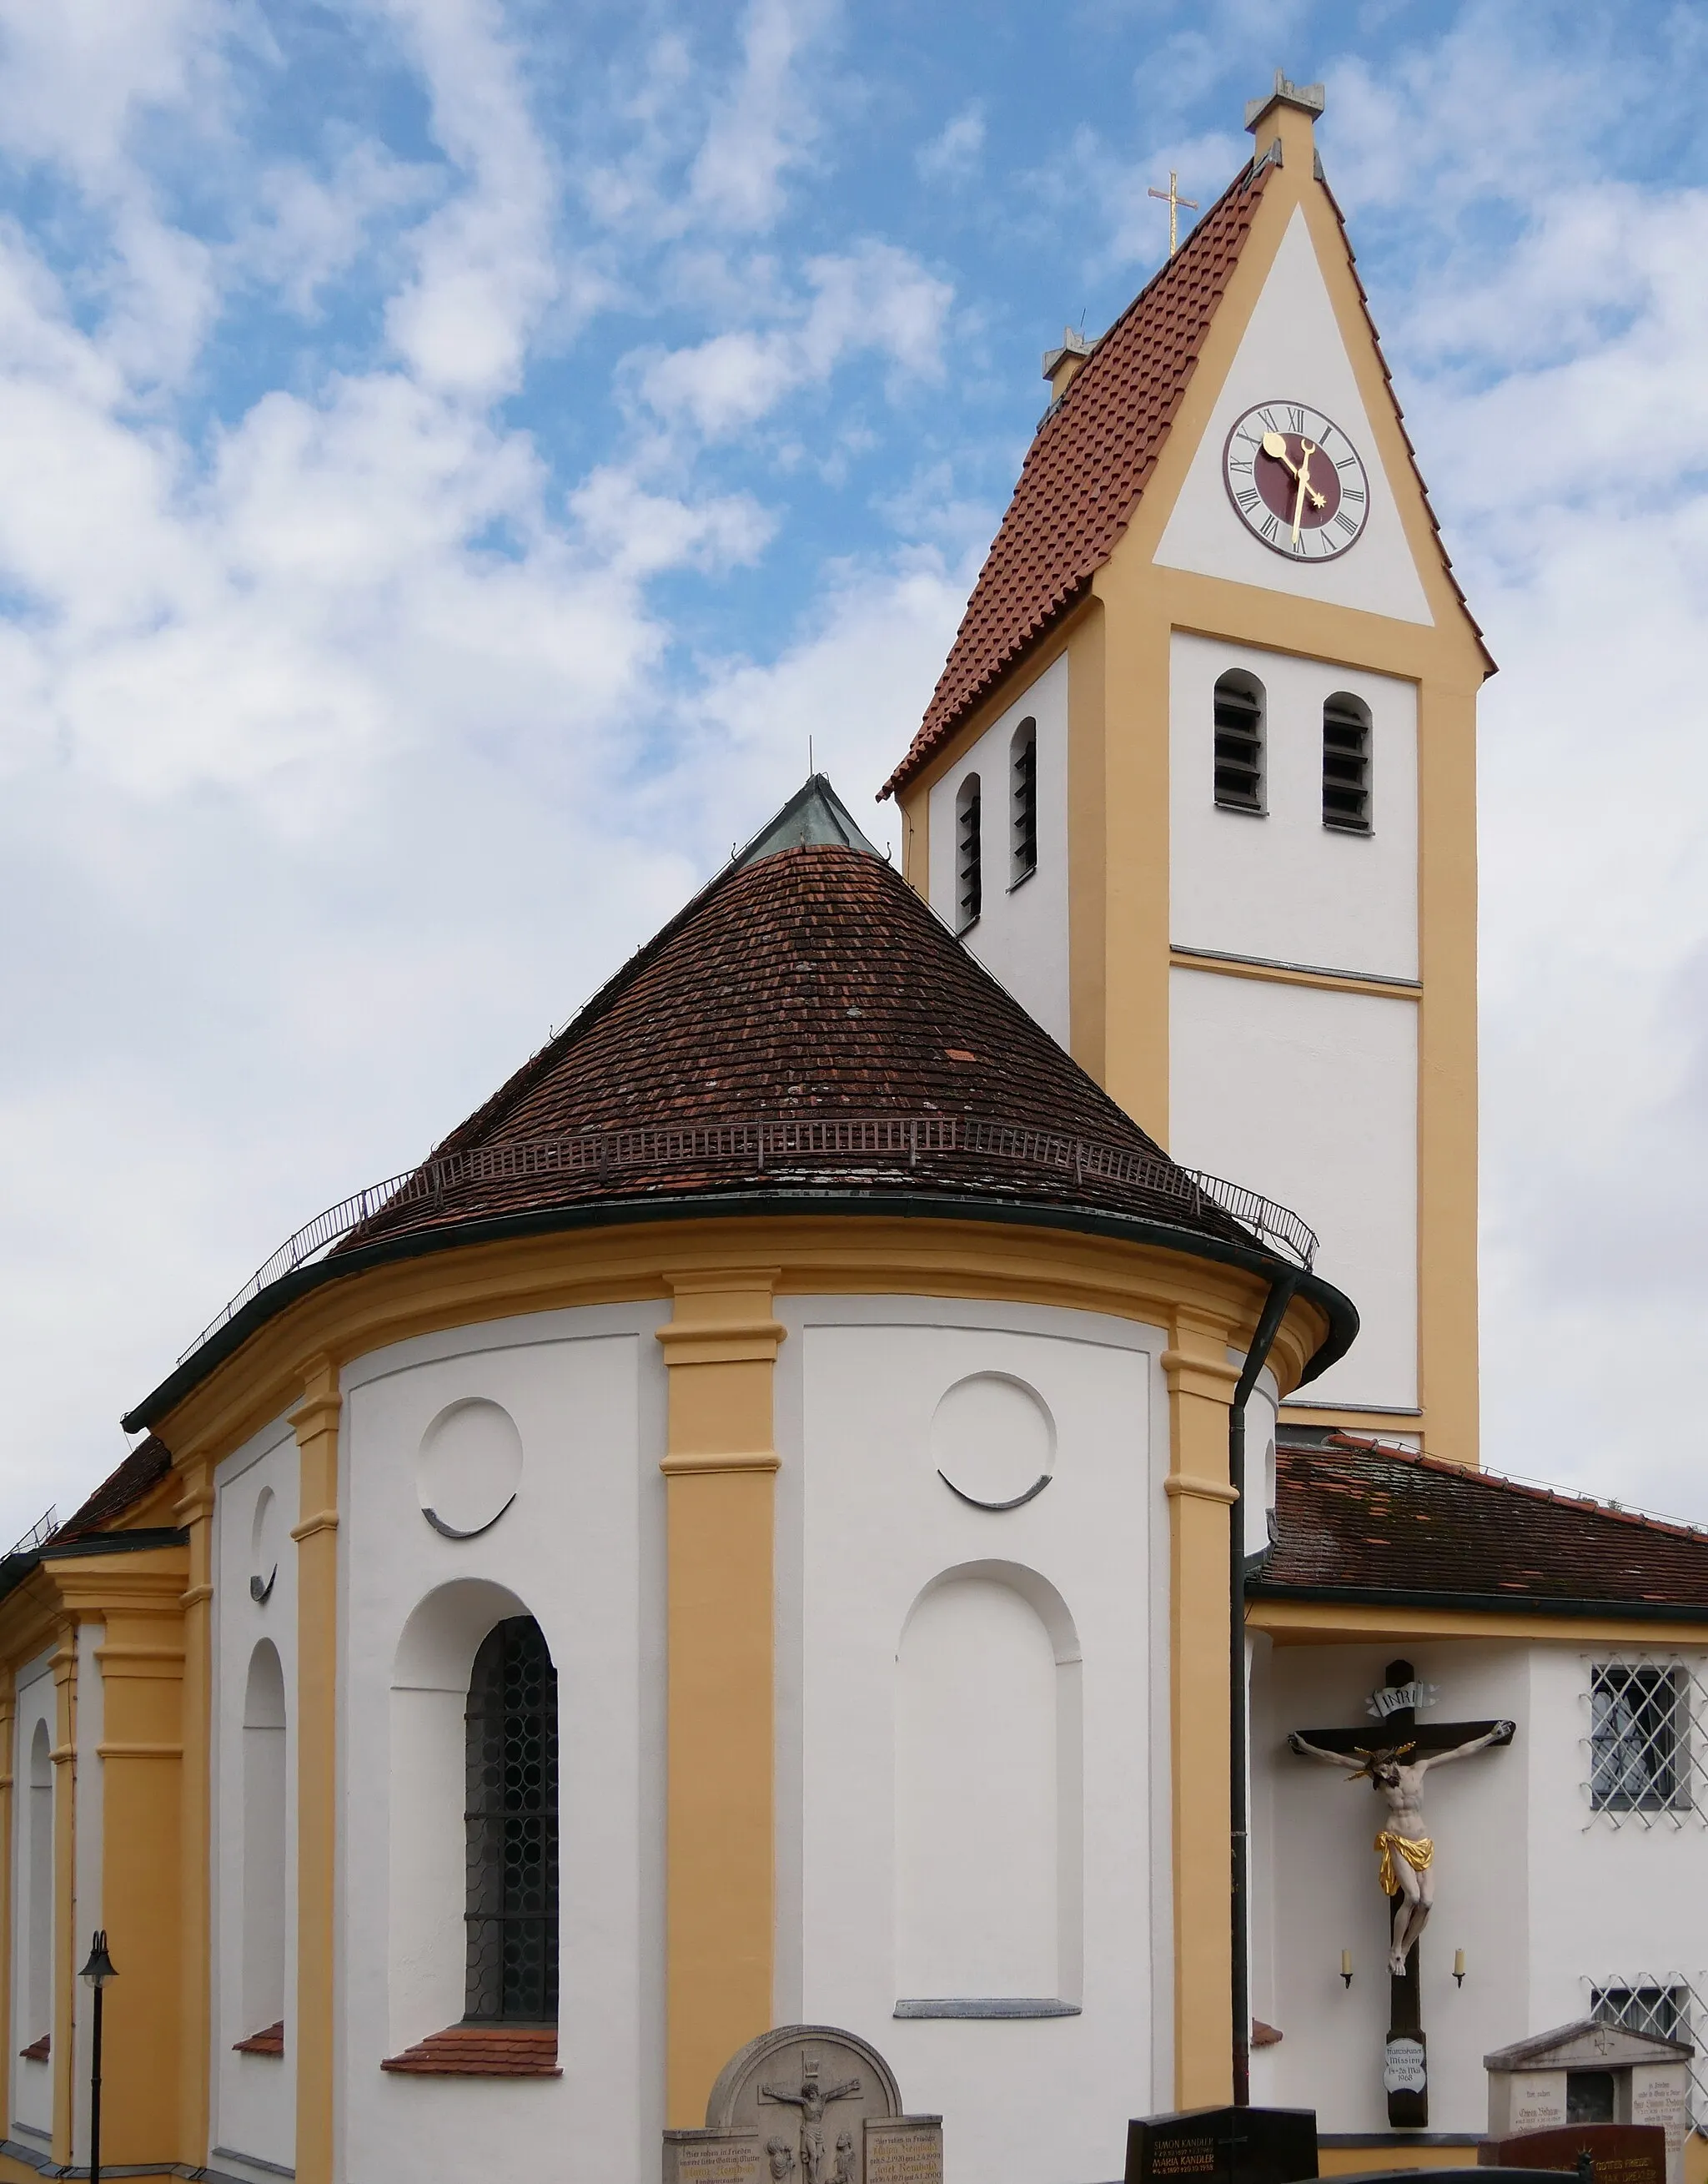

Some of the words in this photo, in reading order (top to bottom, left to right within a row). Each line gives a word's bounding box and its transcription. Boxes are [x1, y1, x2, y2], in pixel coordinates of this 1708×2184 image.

[1288, 407, 1304, 433] XII
[1319, 425, 1333, 446] I
[1230, 455, 1253, 475] IX
[1336, 456, 1356, 470] II
[1342, 487, 1364, 503] III
[1382, 1690, 1415, 1708] INRI
[1398, 2074, 1414, 2082] 1968
[1154, 2140, 1180, 2150] SIMON
[1152, 2157, 1178, 2167] MARIA
[1180, 2154, 1214, 2165] KANDLER
